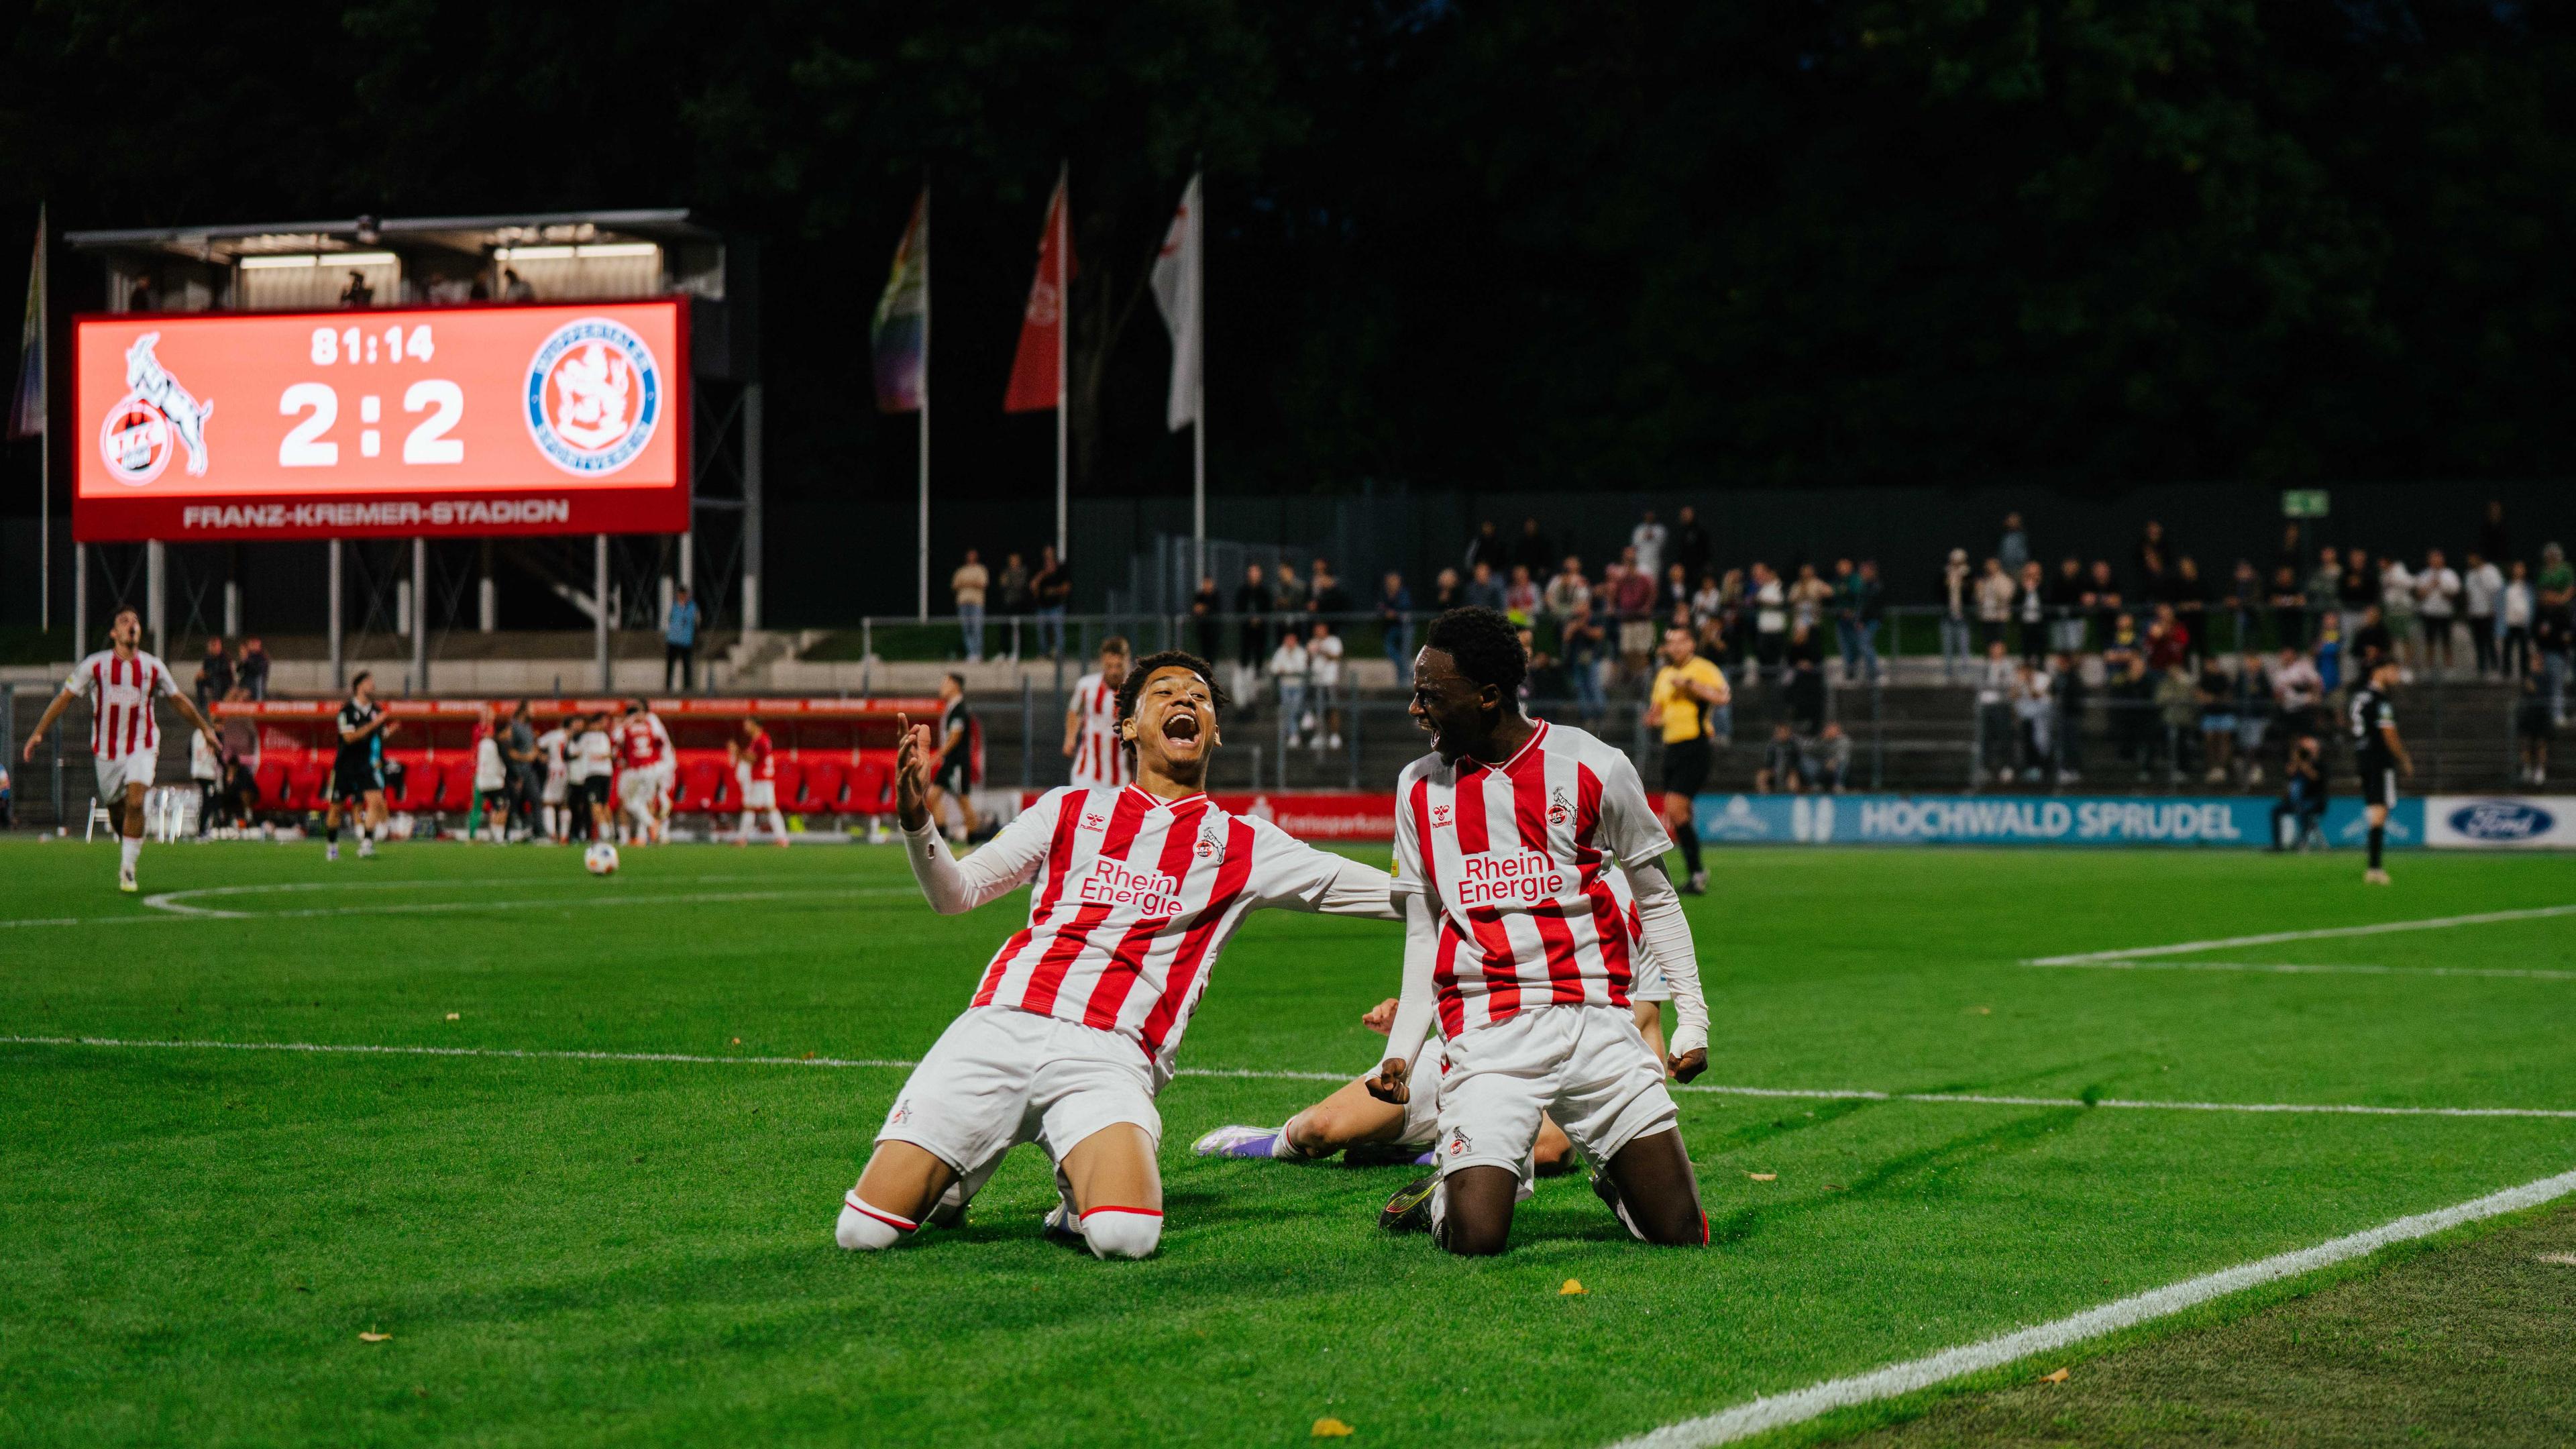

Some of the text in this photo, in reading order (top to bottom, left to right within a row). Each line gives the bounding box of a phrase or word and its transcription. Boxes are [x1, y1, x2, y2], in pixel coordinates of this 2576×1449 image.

[311, 325, 435, 366] 81:14
[183, 499, 569, 528] FRANZ-KREMER-STADION
[1432, 818, 1452, 828] hummel
[1862, 802, 2241, 839] HOCHWALD SPRUDEL
[2465, 804, 2536, 837] Ford
[1095, 859, 1171, 894] Rhein
[1466, 852, 1544, 880] Rhein
[1079, 877, 1183, 916] Energie
[1458, 875, 1562, 905] Energie
